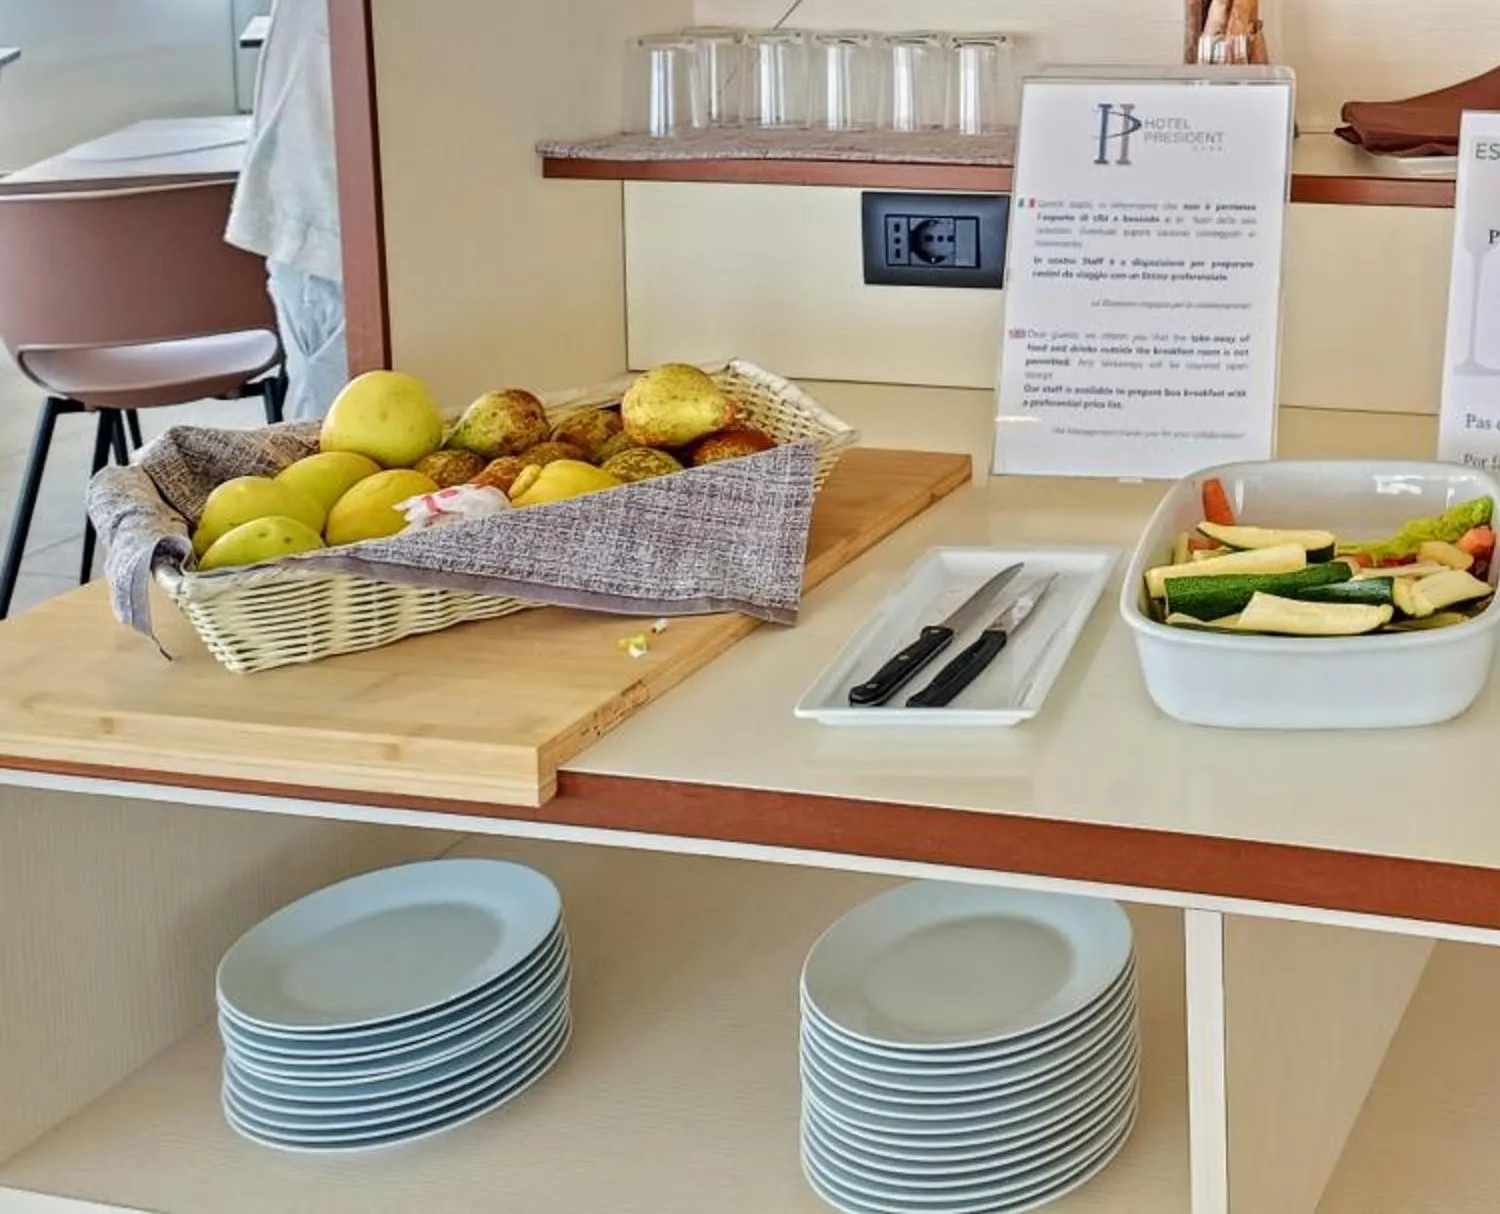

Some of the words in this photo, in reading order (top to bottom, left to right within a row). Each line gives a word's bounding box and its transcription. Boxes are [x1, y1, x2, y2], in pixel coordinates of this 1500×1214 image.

[1144, 117, 1192, 130] HOTEL
[1144, 131, 1224, 145] PRESIDENT
[1466, 413, 1491, 429] Pas
[1462, 452, 1487, 470] Por
